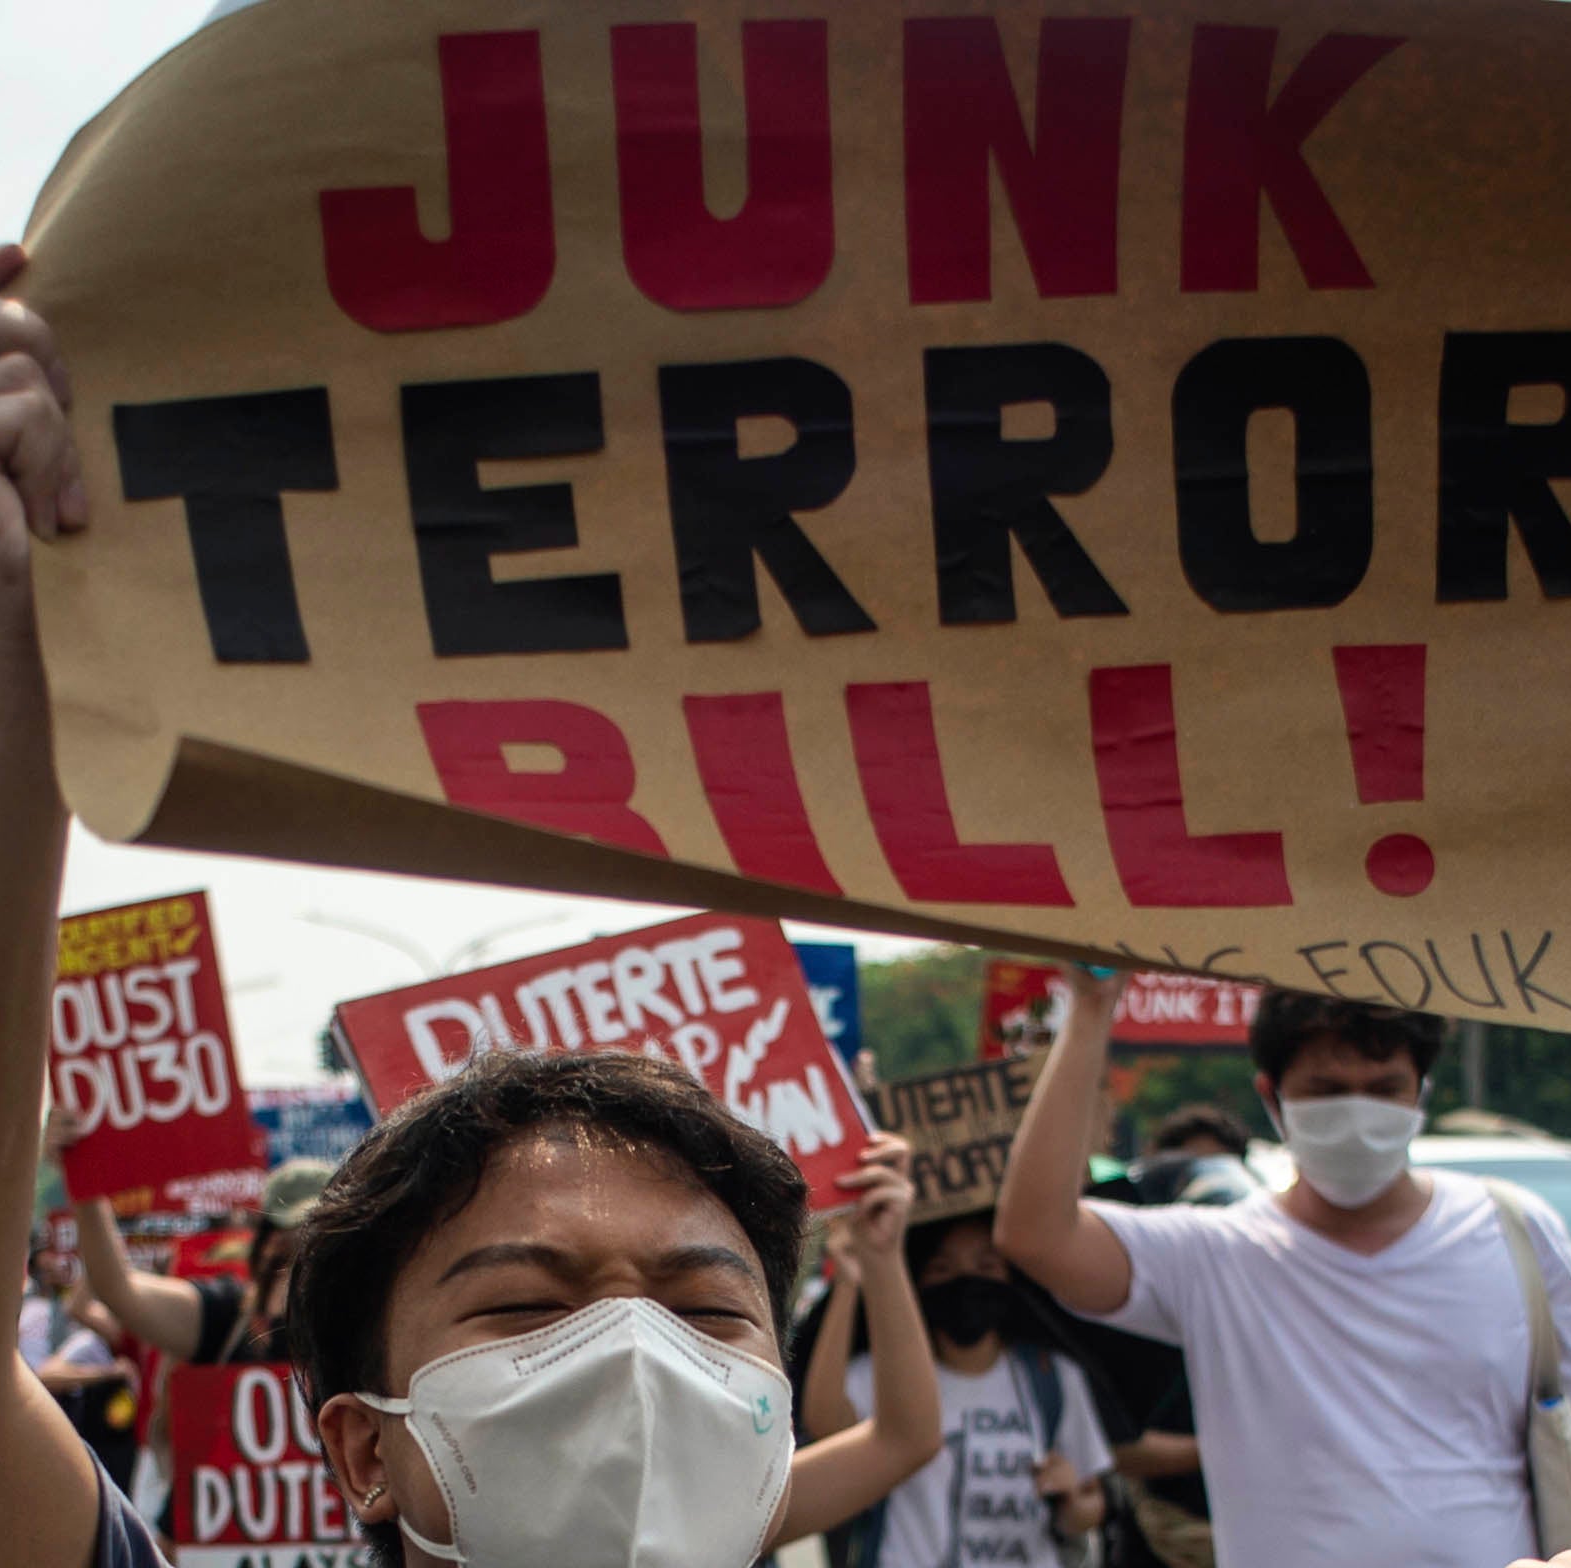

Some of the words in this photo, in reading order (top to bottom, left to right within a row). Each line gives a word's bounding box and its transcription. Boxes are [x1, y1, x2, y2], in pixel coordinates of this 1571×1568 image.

[318, 10, 1408, 334] JUNK
[414, 641, 1439, 910] BILL!
[51, 957, 202, 1056] OUST
[54, 1032, 231, 1137] DU30
[403, 926, 760, 1090] DUTERTE
